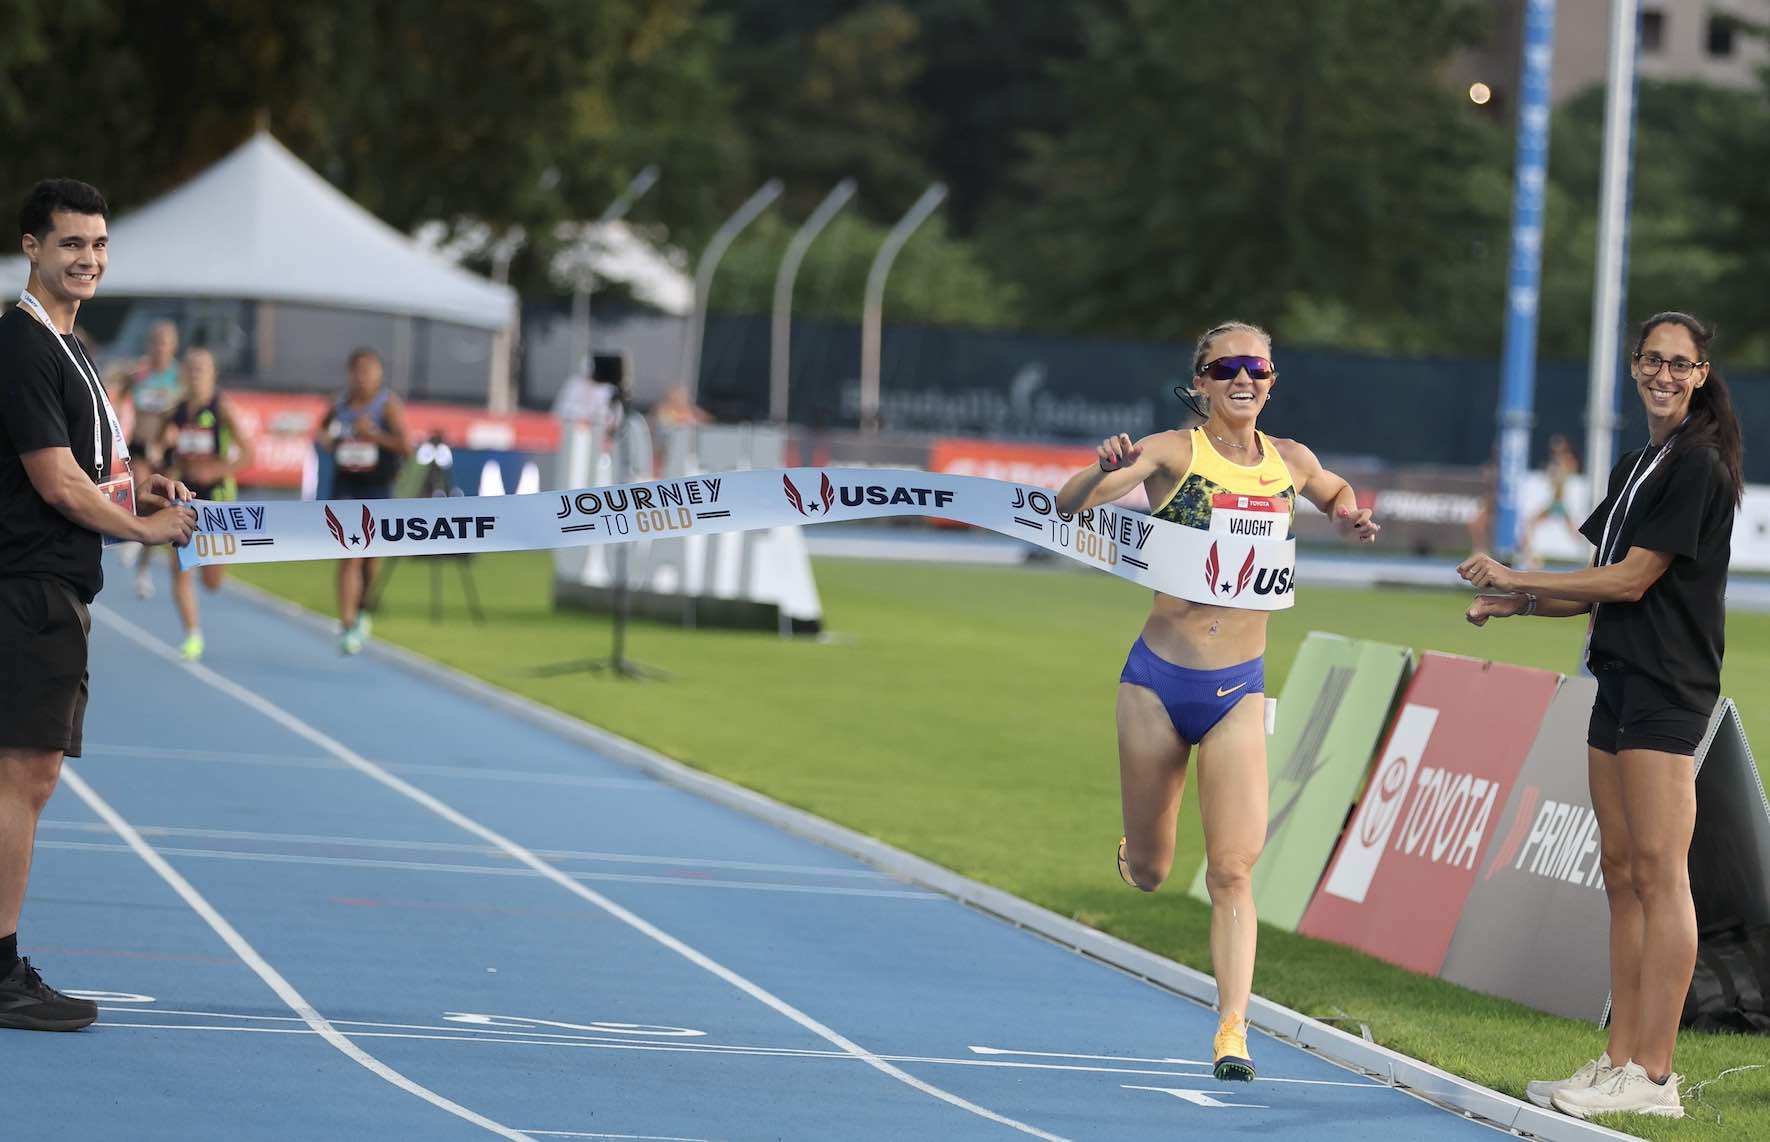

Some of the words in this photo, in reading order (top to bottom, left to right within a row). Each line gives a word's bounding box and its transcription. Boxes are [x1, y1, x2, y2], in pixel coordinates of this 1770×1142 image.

[557, 478, 721, 519] JOURNEY
[839, 486, 954, 508] USATF
[1249, 500, 1270, 508] TOYOTA
[381, 516, 496, 542] USATF
[600, 513, 629, 536] TO
[635, 507, 693, 533] GOLD
[1229, 517, 1274, 536] VAUGHT
[1048, 518, 1071, 548] TO
[1076, 529, 1119, 566] GOLD
[1394, 767, 1500, 870] TOYOTA
